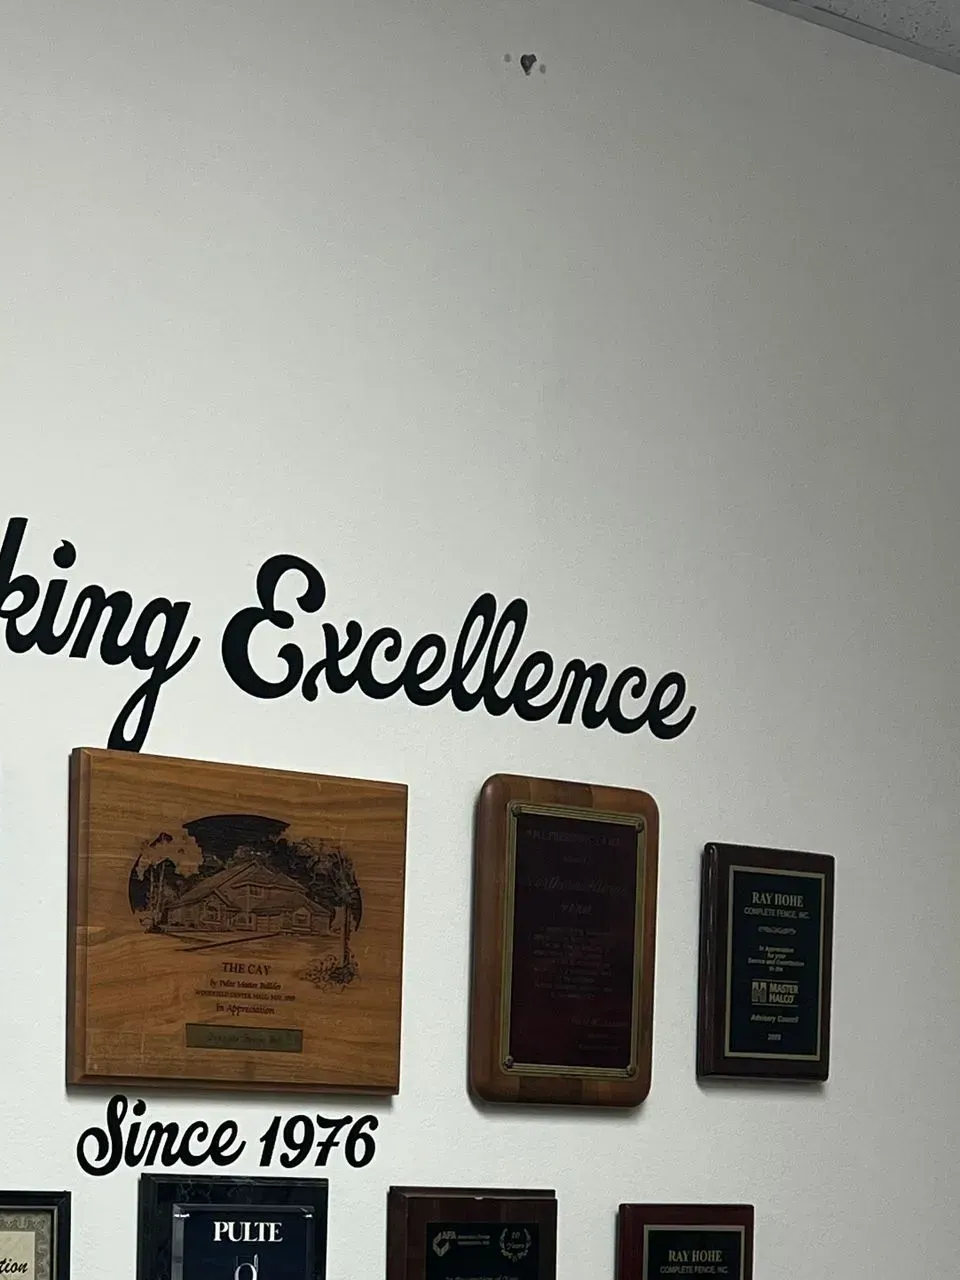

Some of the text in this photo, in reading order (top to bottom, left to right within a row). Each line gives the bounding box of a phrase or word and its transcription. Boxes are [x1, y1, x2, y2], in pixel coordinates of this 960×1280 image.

[222, 555, 696, 739] Excellence
[752, 891, 804, 907] RAY HOHE
[744, 906, 776, 917] COMPLETE
[222, 962, 271, 976] THE CAY
[769, 982, 799, 994] MASTER
[769, 994, 794, 1004] HALCO
[216, 1003, 224, 1012] In
[76, 1094, 379, 1176] Since 1976
[213, 1221, 284, 1242] PULTE
[442, 1230, 456, 1240] AFA
[668, 1250, 722, 1262] RAY HOHE
[660, 1265, 694, 1274] COMPLETE
